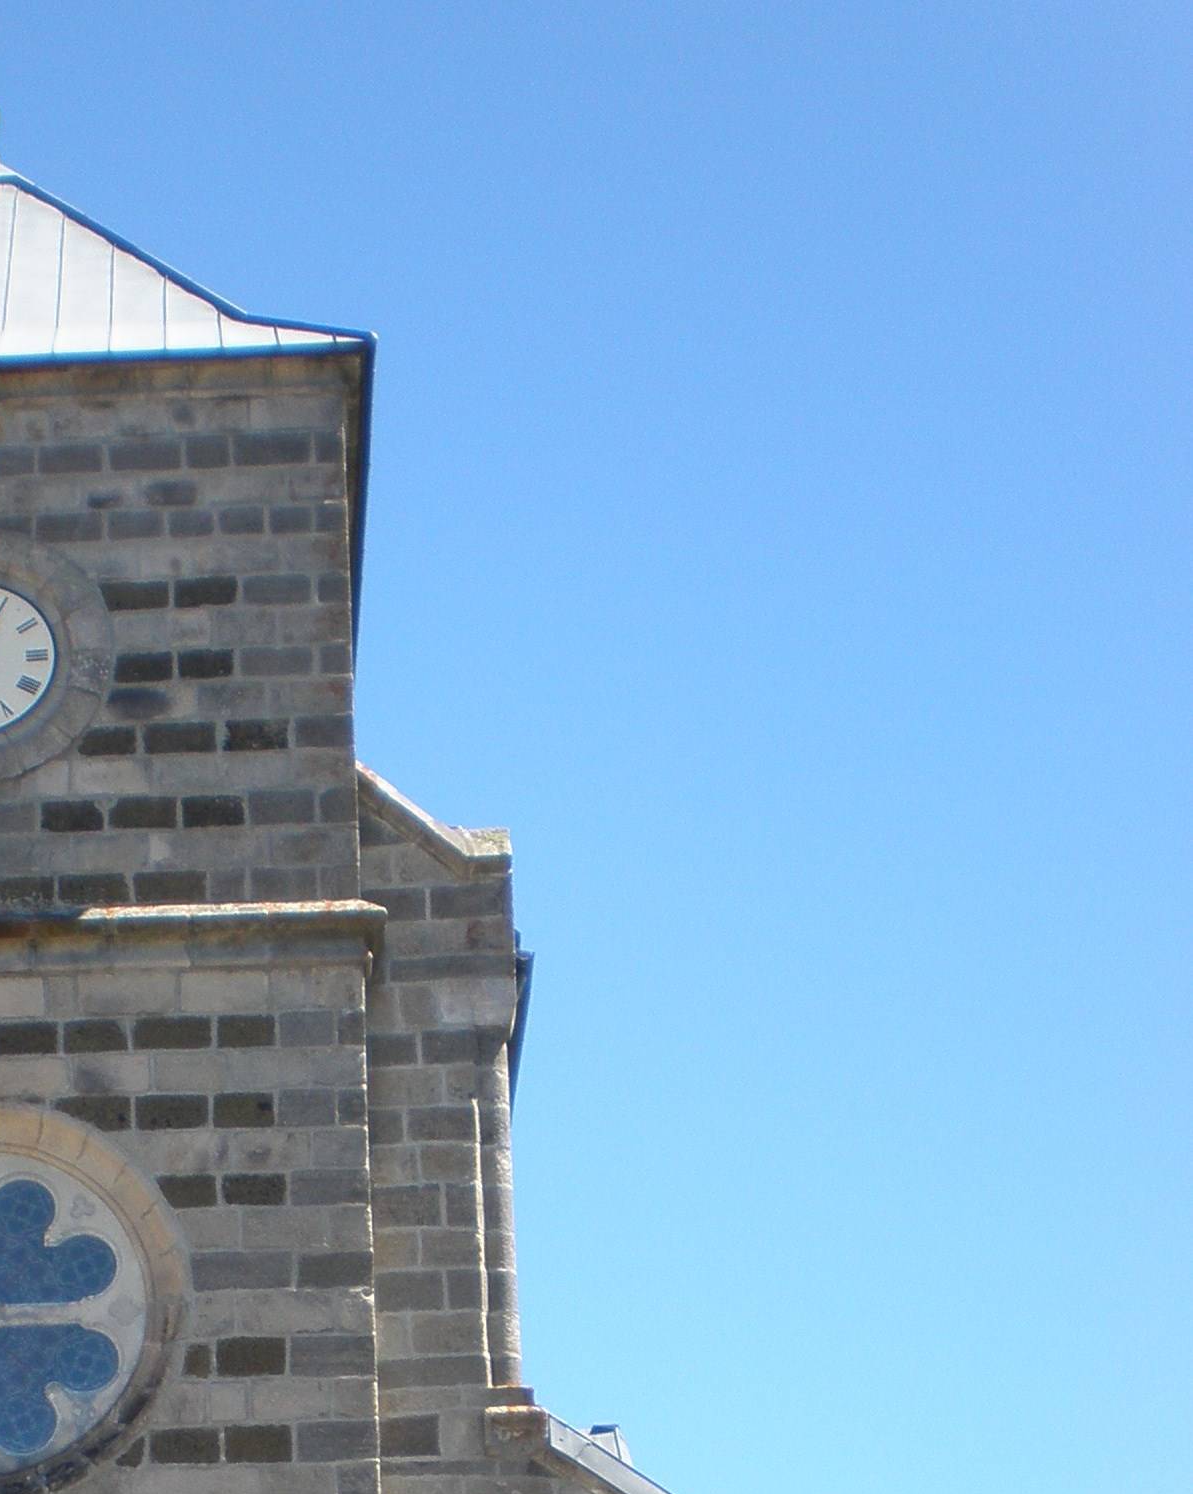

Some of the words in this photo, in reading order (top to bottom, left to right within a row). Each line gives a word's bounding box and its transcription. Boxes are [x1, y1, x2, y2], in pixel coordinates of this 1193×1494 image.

[16, 617, 38, 634] II
[25, 649, 49, 662] III
[16, 675, 42, 695] IIII
[0, 700, 14, 718] V
